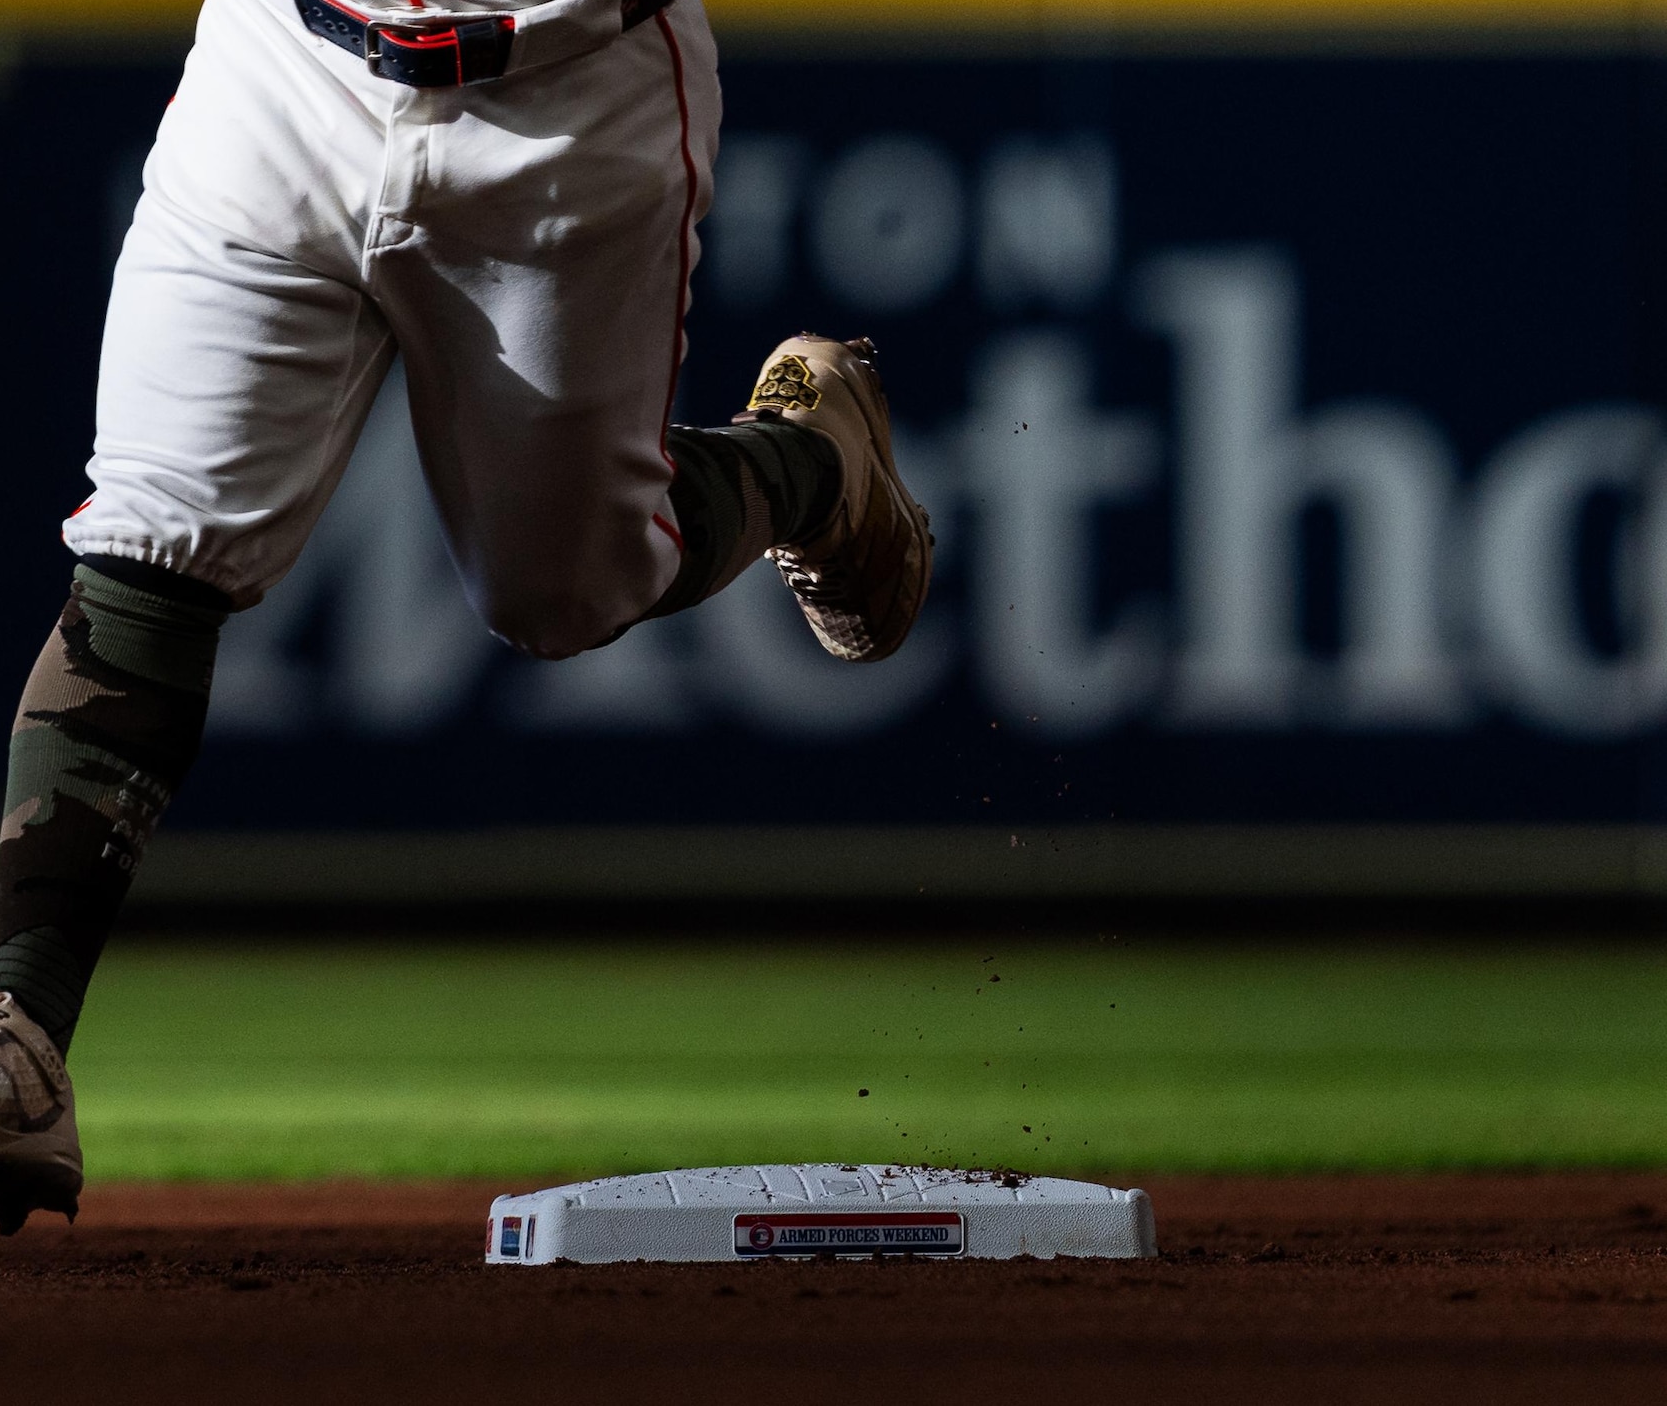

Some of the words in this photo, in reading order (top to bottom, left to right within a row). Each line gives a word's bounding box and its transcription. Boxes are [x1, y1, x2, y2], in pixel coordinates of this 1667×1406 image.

[779, 1229, 826, 1243] ARMED
[829, 1229, 879, 1242] FORCES
[882, 1227, 949, 1242] WEEKEND
